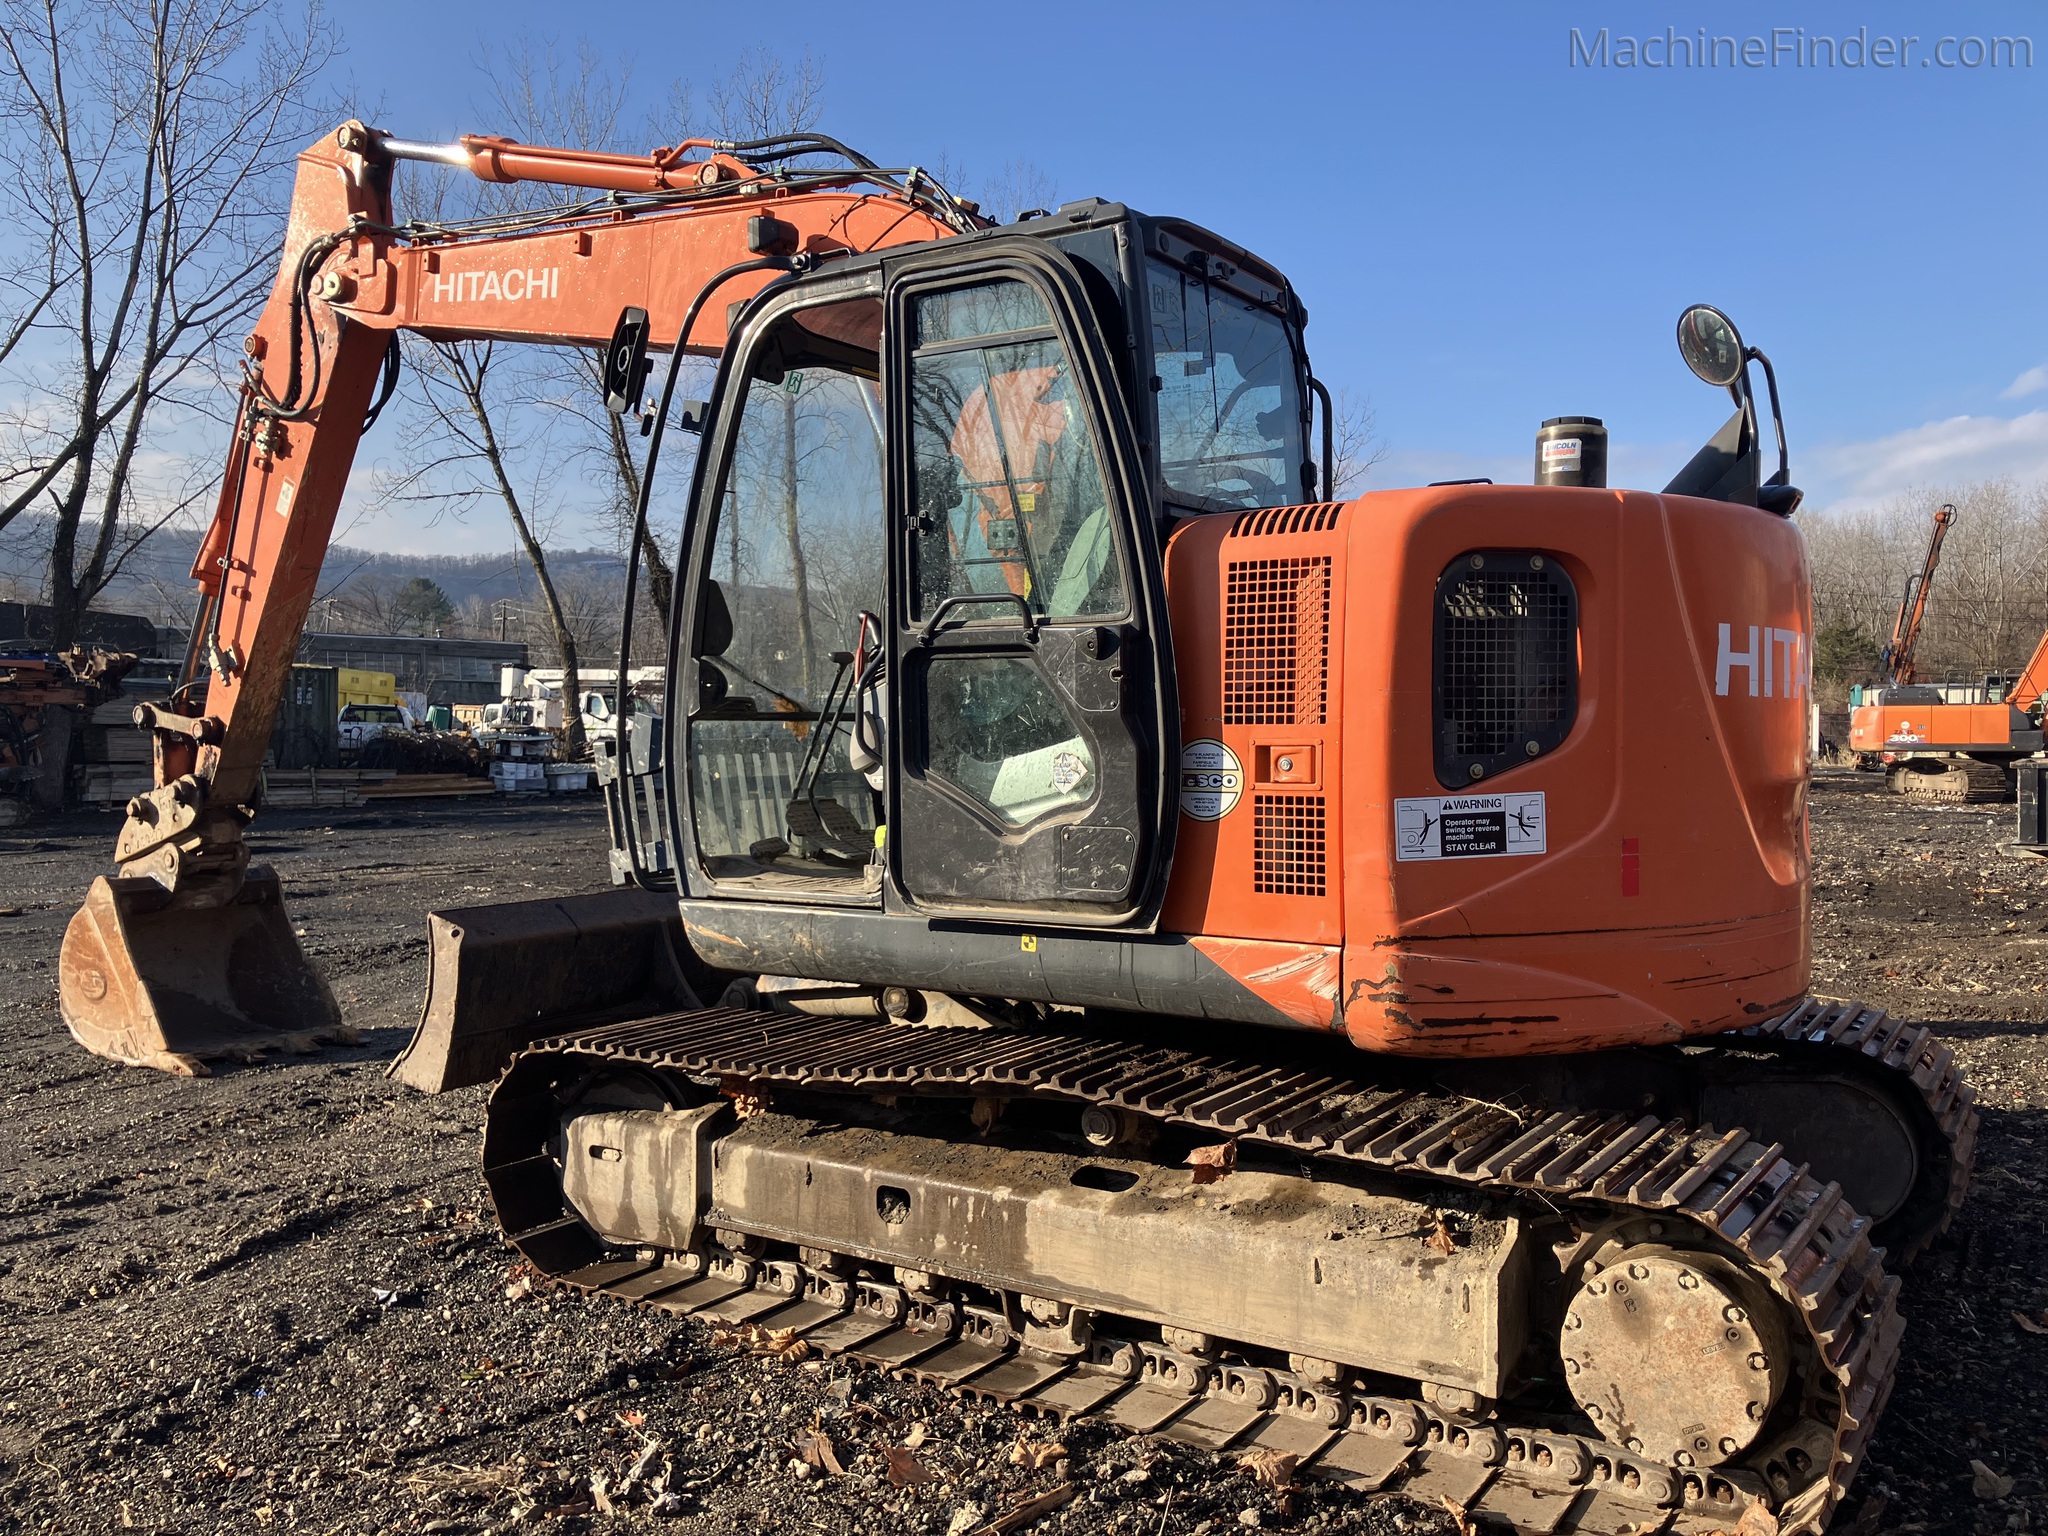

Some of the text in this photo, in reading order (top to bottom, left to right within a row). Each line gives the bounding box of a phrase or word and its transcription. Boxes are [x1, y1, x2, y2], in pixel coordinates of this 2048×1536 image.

[433, 267, 559, 303] HITACHI
[1546, 442, 1577, 450] LINCOLN
[1889, 734, 1918, 743] 300
[1453, 798, 1502, 810] WARNING
[1445, 818, 1490, 828] Operator may
[1445, 827, 1466, 835] swing
[1445, 833, 1475, 841] machine
[1446, 842, 1497, 852] STAY CLEAR
